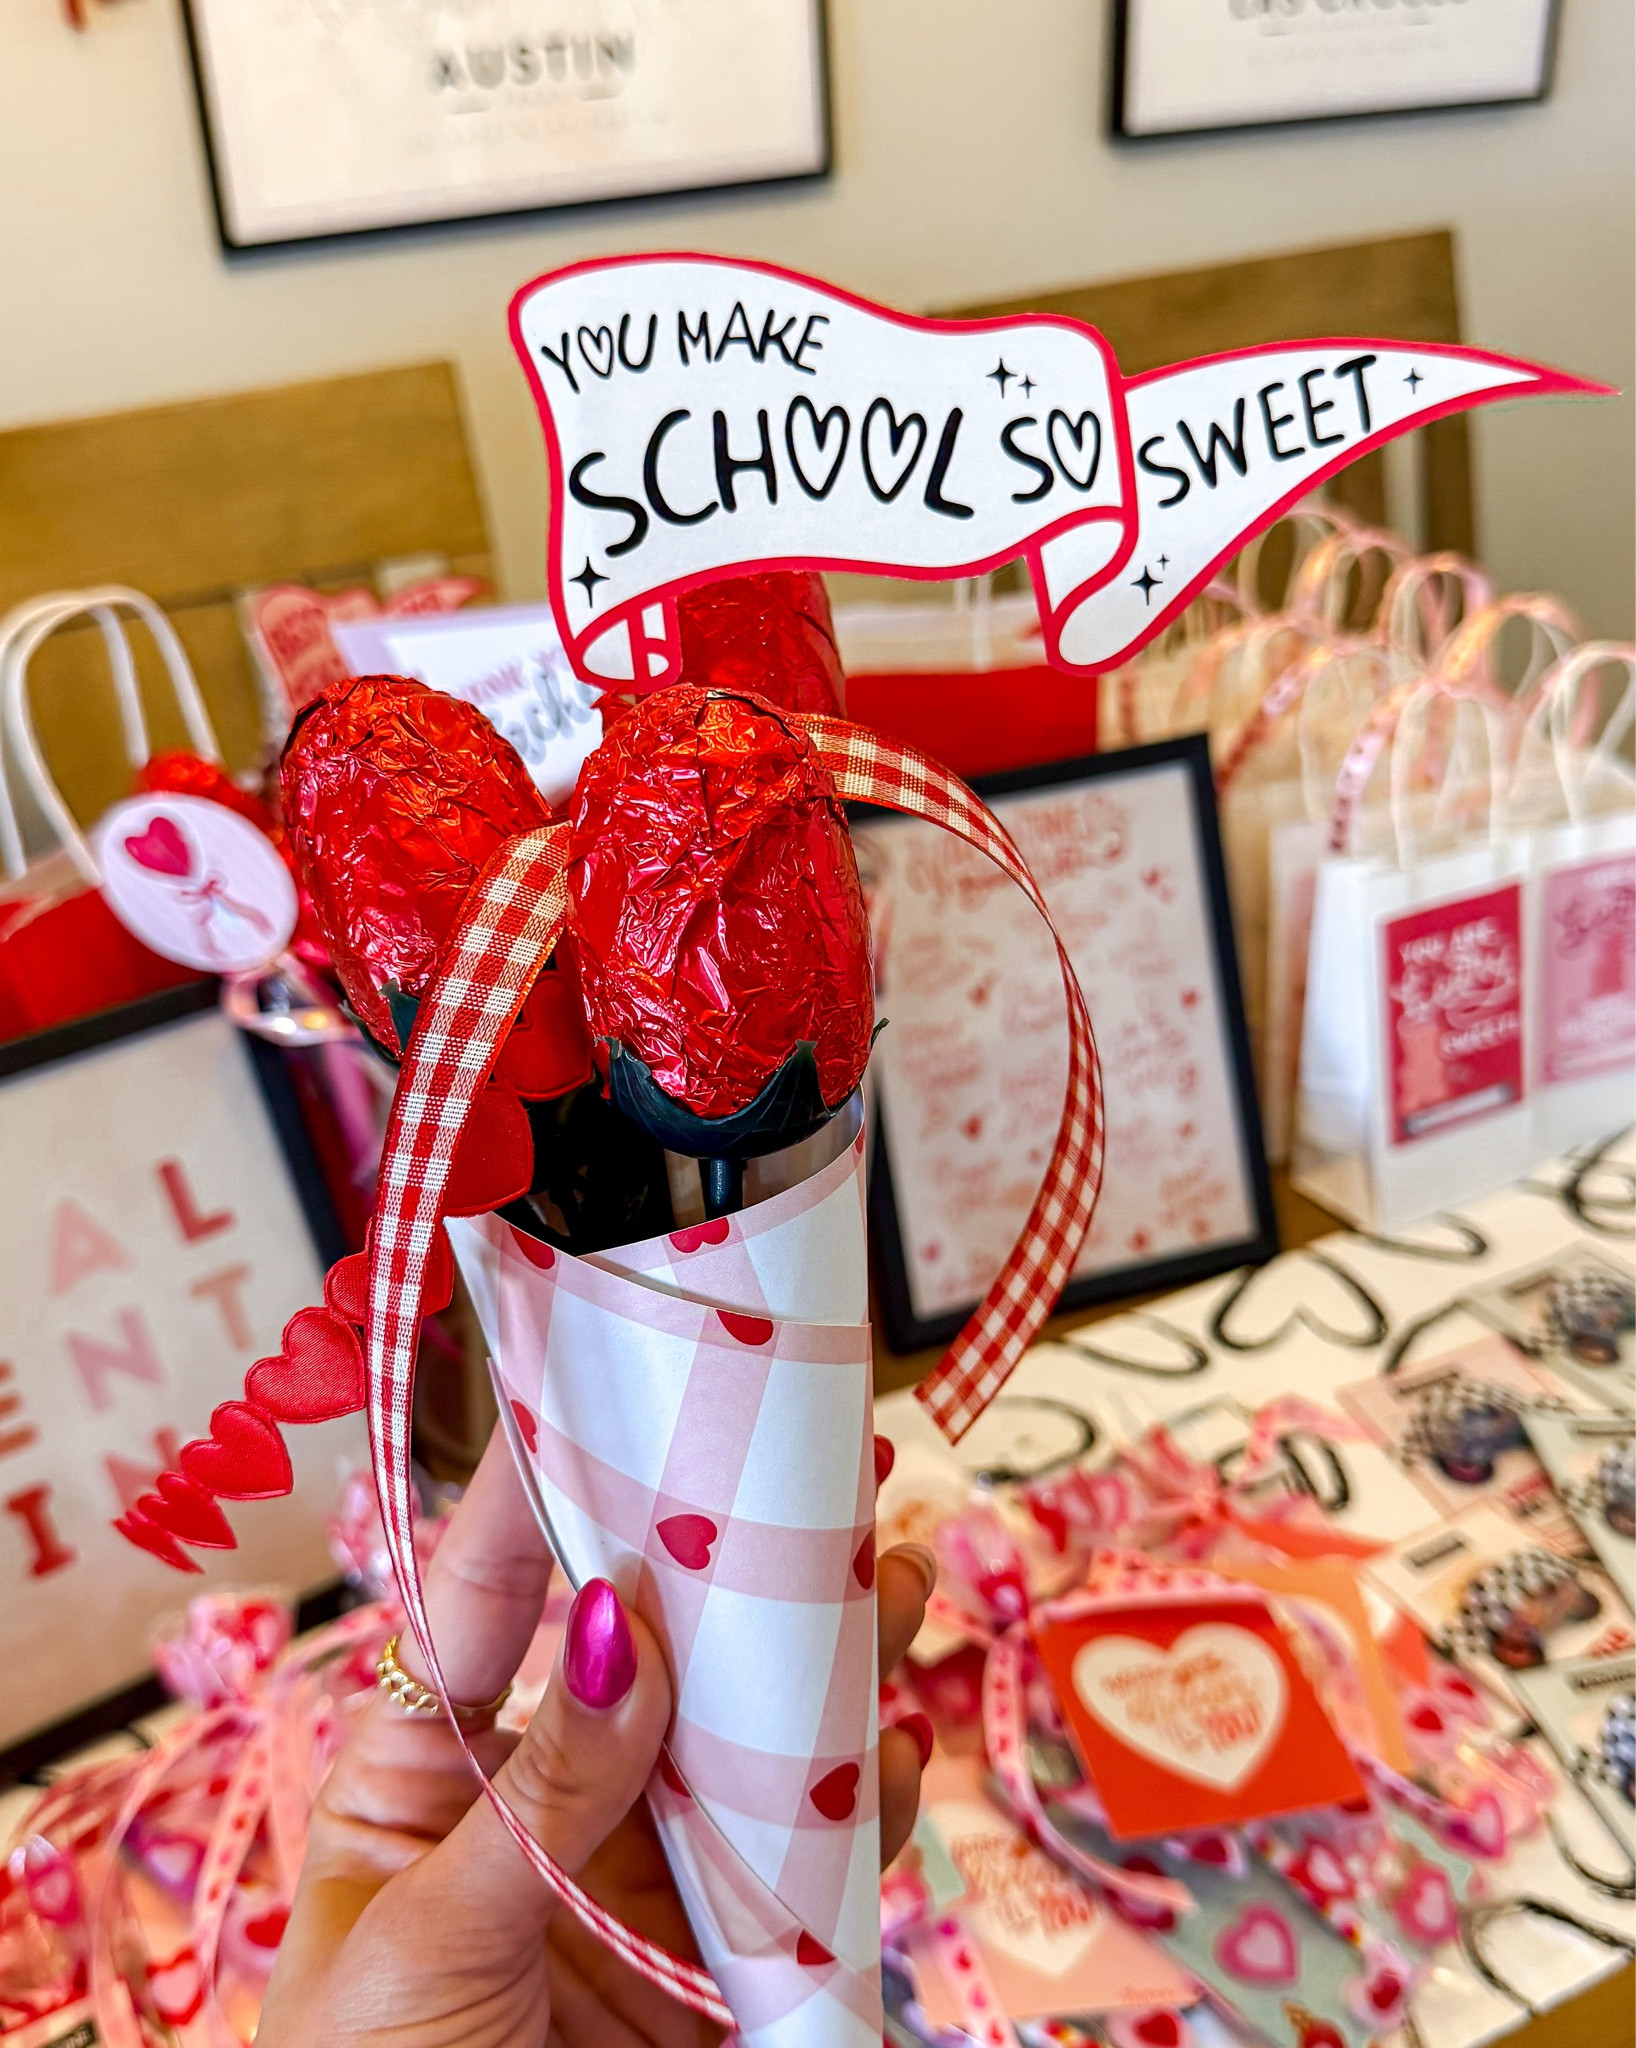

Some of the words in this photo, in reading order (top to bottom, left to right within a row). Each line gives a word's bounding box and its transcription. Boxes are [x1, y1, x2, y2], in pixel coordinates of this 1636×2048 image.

[428, 30, 638, 95] AUSTIN
[540, 312, 658, 395] YOU
[678, 300, 831, 376] MAKE
[567, 394, 977, 558] SCHOOL
[999, 407, 1103, 504] SO
[1137, 354, 1378, 508] SWEET
